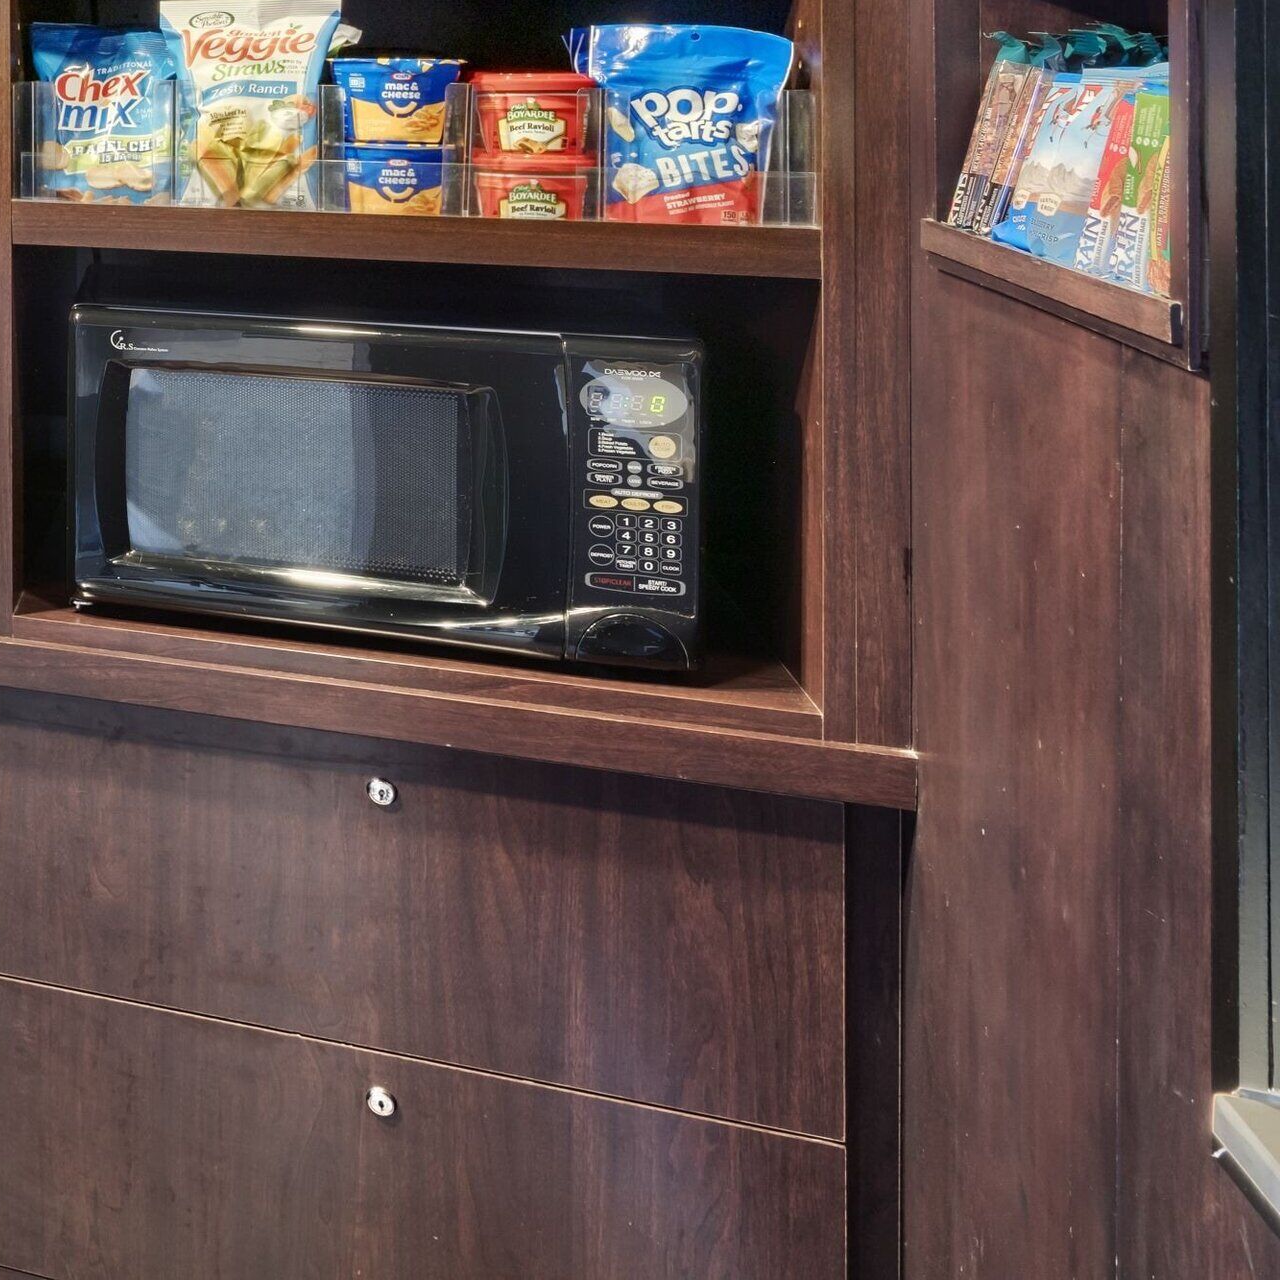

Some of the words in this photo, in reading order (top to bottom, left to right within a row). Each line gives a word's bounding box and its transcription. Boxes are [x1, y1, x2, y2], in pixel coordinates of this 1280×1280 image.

[182, 28, 316, 70] Veggie
[96, 60, 153, 76] TRADITIONAL
[212, 60, 286, 82] Straws
[56, 70, 150, 103] Chex
[385, 82, 409, 91] mac
[410, 82, 418, 91] &
[211, 84, 245, 100] Zesty
[248, 83, 289, 95] Ranch
[507, 109, 555, 122] BOYARDEE
[509, 123, 526, 133] Beef
[527, 122, 555, 133] Ravioli
[656, 145, 750, 187] BITES
[382, 169, 406, 177] mac
[406, 168, 415, 177] &
[508, 192, 556, 204] BOYARDEE
[666, 193, 726, 209] STRAWBERRY
[948, 172, 968, 225] KIND
[511, 205, 528, 214] Beef
[529, 204, 556, 215] Ravioli
[604, 368, 648, 377] DAEWOO
[623, 517, 629, 526] 1
[644, 519, 654, 528] 2
[667, 521, 676, 530] 3
[621, 531, 631, 540] 4
[644, 533, 654, 542] 5
[666, 535, 676, 544] 6
[622, 545, 631, 554] 7
[644, 547, 653, 556] 8
[666, 549, 676, 558] 9
[644, 562, 653, 571] 0
[638, 583, 660, 591] SPEEDY
